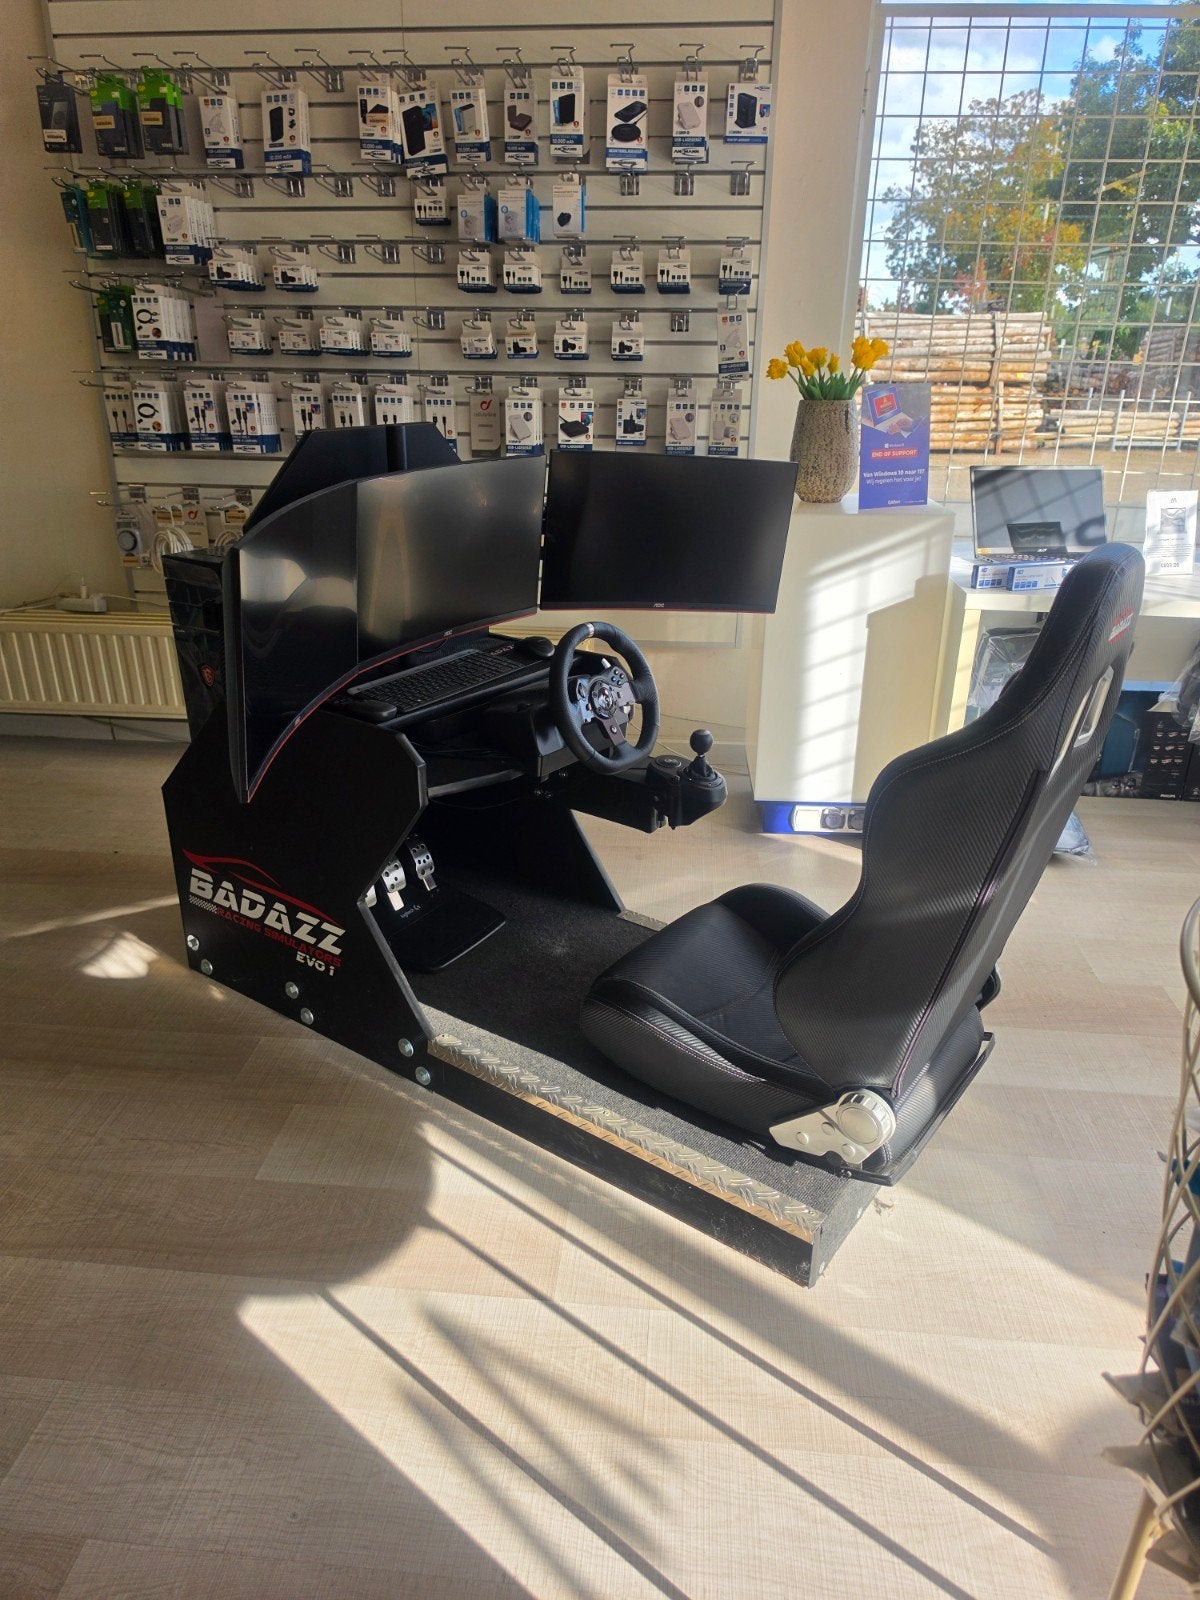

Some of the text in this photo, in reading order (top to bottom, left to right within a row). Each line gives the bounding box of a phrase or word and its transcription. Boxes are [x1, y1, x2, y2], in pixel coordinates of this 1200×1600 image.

[871, 450, 882, 458] END
[891, 449, 917, 457] SUPPORT
[189, 867, 346, 956] BADAZZ
[216, 908, 342, 967] RACING SIMULATORS
[295, 952, 325, 971] EVO
